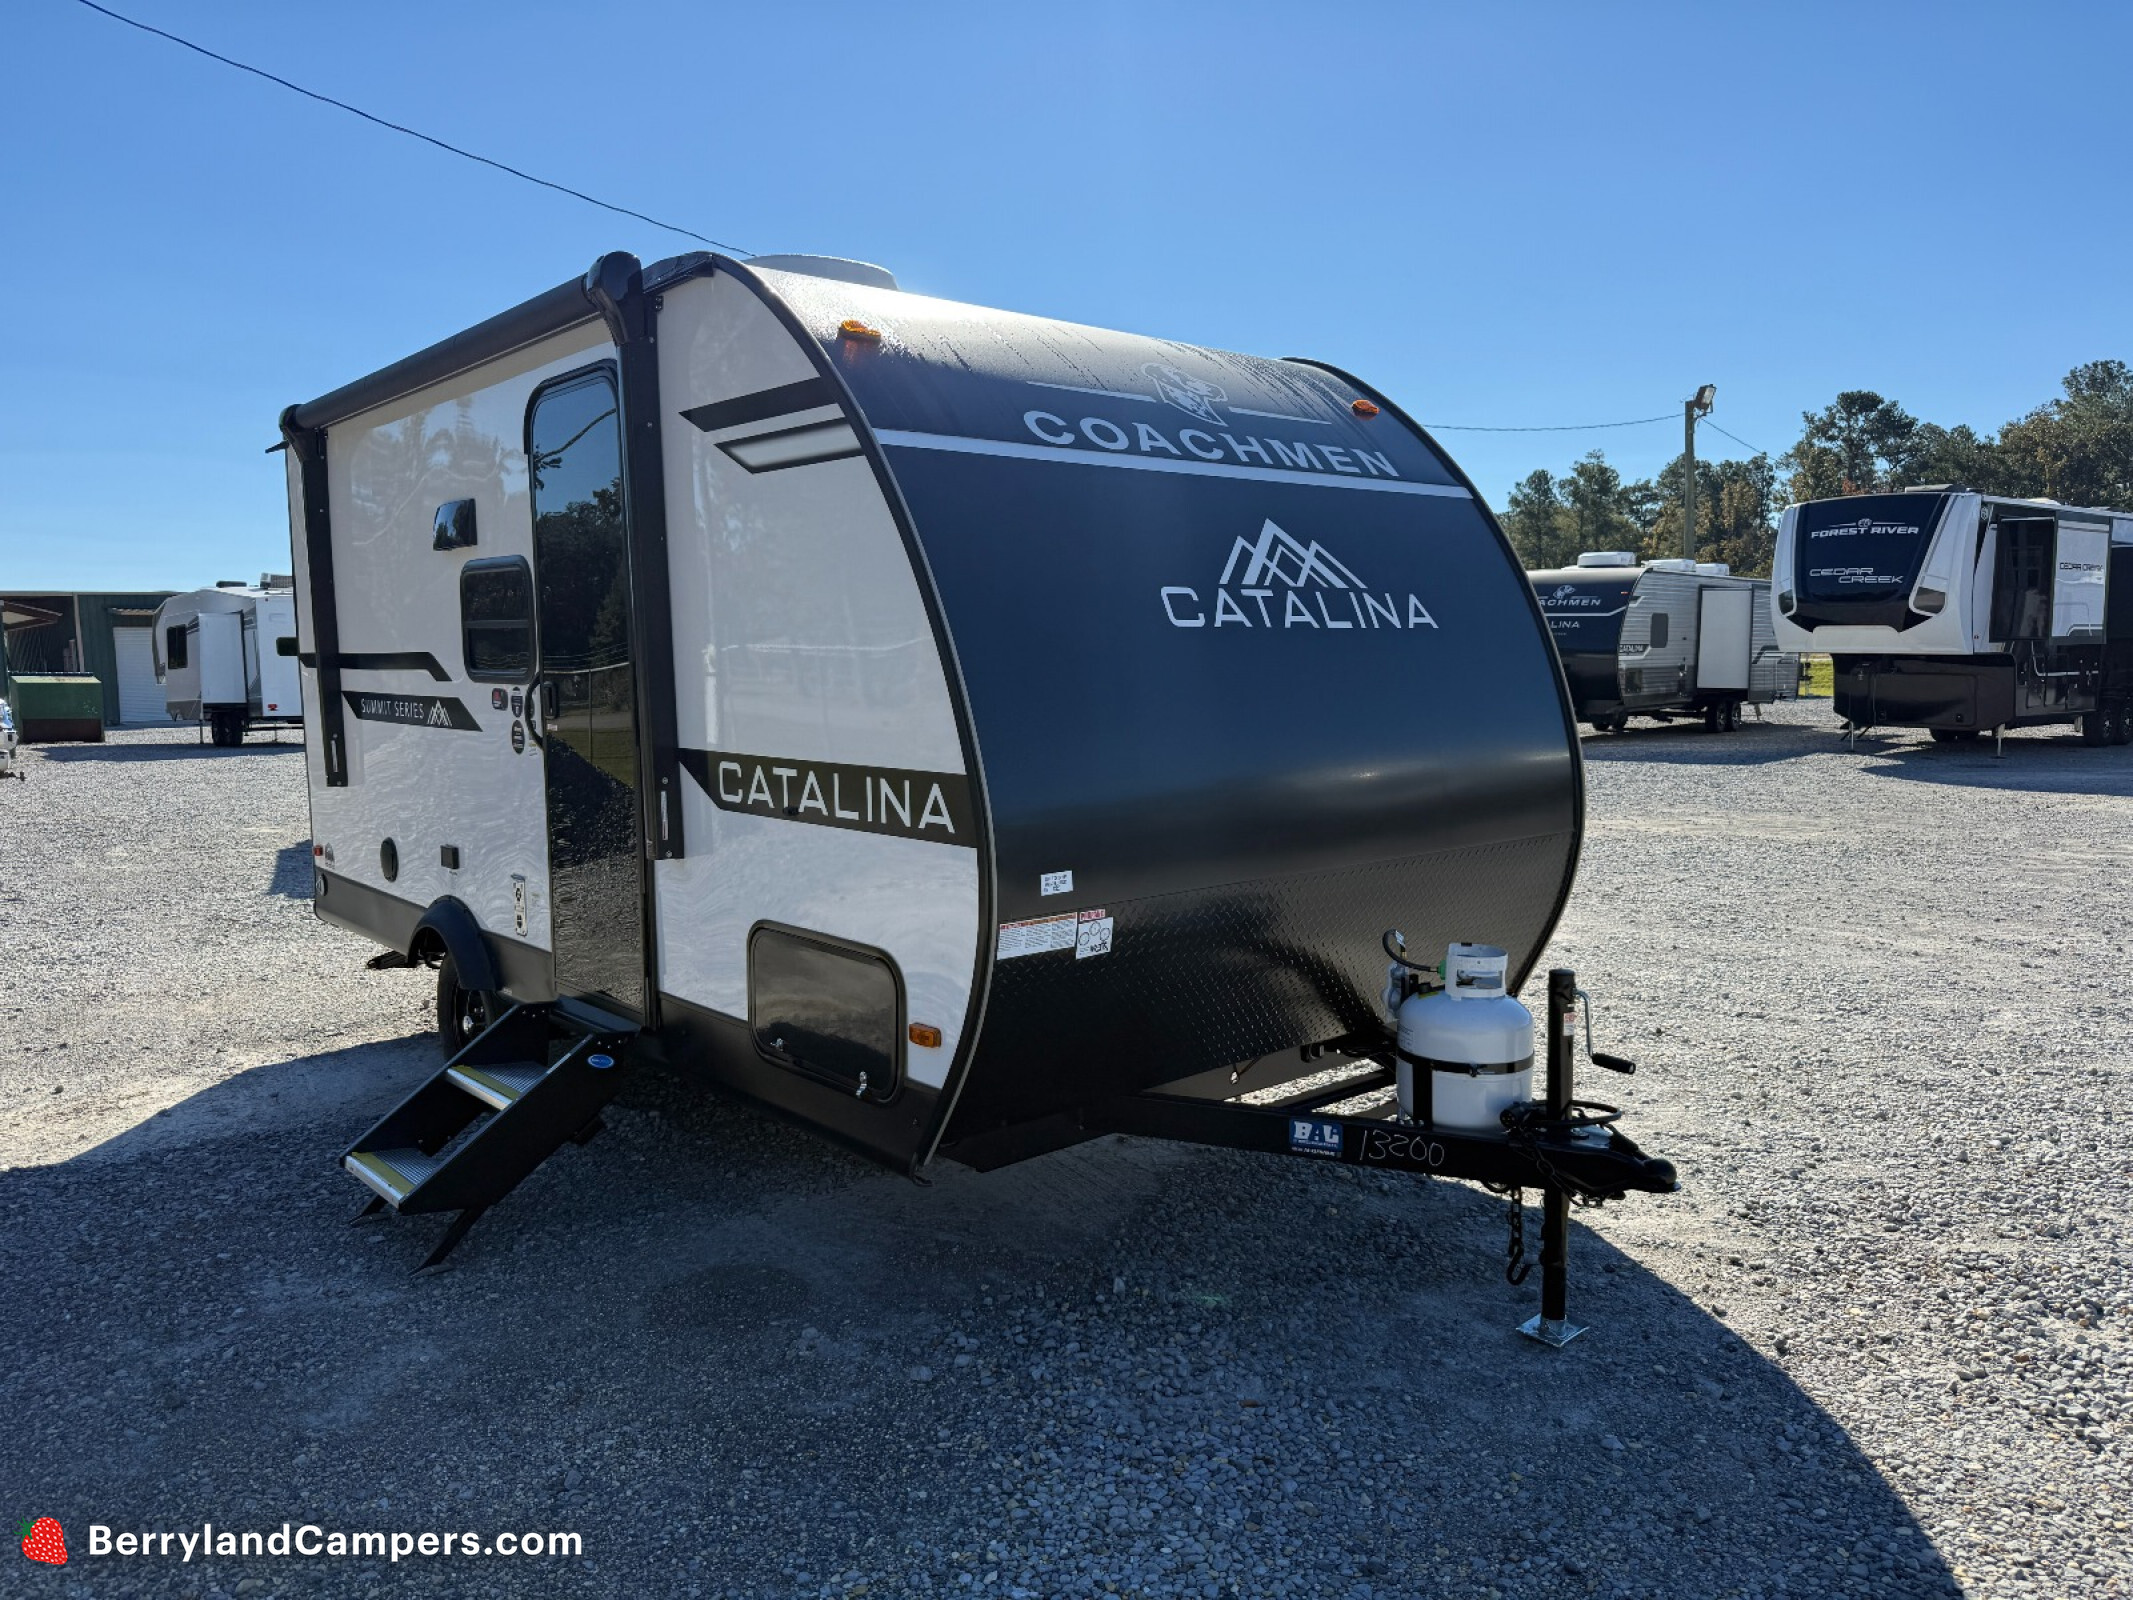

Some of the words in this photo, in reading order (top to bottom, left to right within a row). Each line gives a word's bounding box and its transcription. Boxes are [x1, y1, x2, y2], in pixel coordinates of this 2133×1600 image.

[1023, 410, 1400, 477] COACHMEN
[1811, 527, 1869, 539] FOREST
[1870, 526, 1919, 535] RIVER
[1809, 567, 1874, 577] CEDAR
[1838, 575, 1904, 584] CREEK
[1161, 585, 1439, 629] CATALINA
[360, 698, 392, 715] SUMMIT
[394, 702, 425, 719] SERIES
[718, 760, 956, 834] CATALINA
[1359, 1129, 1445, 1167] 13200
